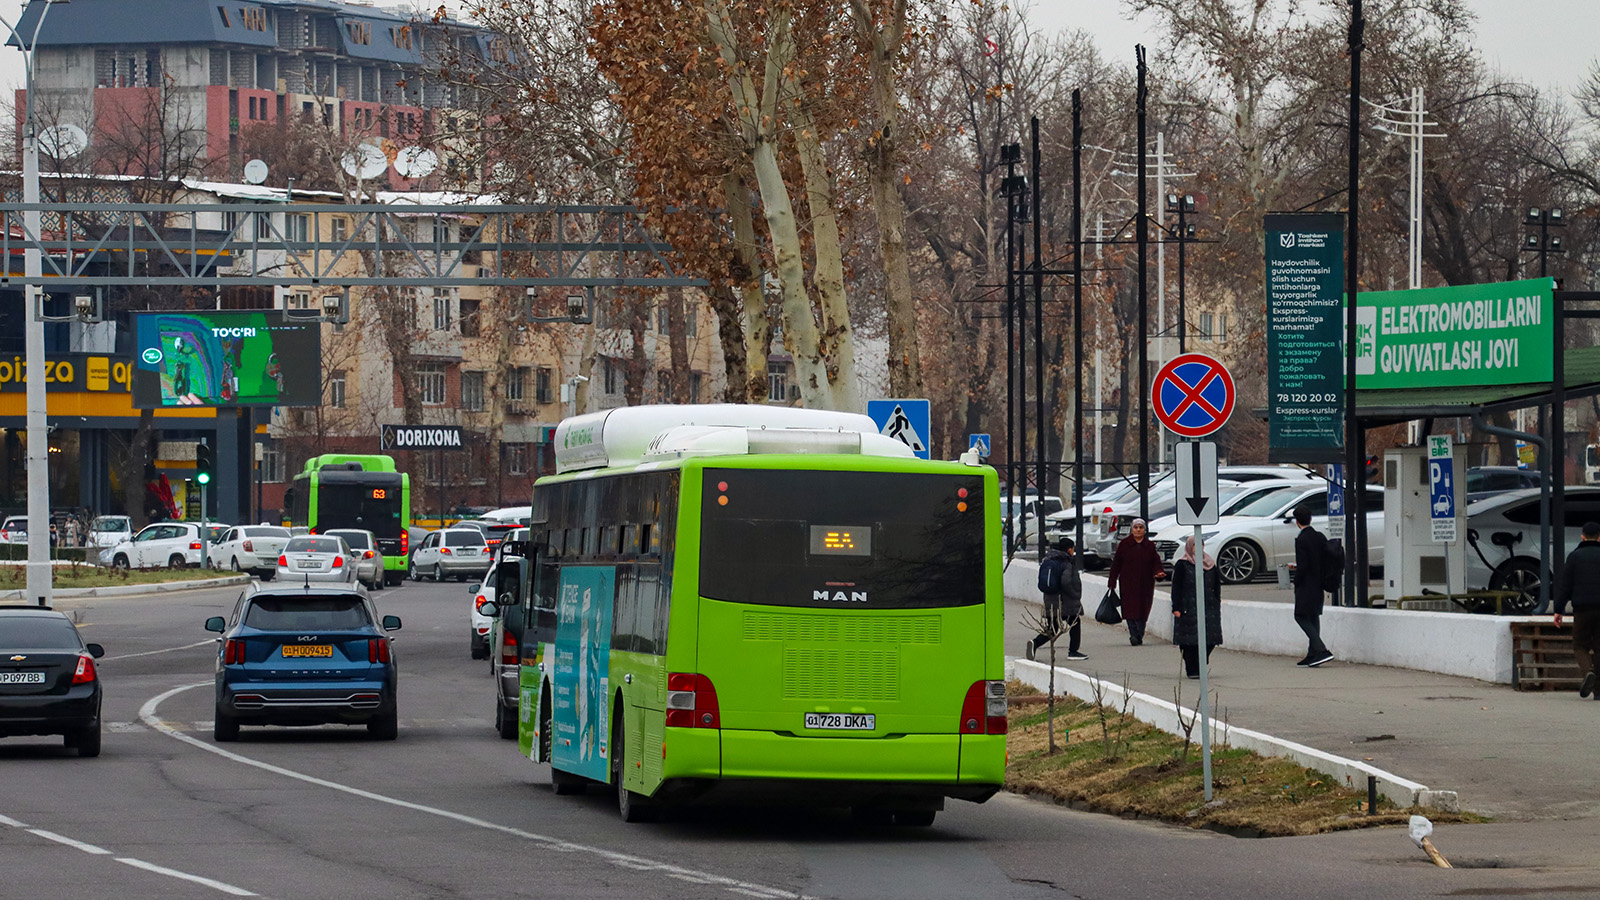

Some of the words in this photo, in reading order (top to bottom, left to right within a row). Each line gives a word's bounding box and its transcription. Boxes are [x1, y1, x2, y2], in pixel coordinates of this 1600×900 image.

[1271, 267, 1331, 275] guvohnomasini
[1272, 283, 1321, 291] imtihonlarga
[1381, 295, 1541, 335] ELEKTROMOBILLARNI
[1272, 323, 1315, 331] marhamat!
[1290, 357, 1317, 365] права?
[1380, 340, 1481, 374] QUVVATLASH
[1485, 338, 1519, 369] JOYI
[1276, 394, 1289, 402] 78
[1291, 394, 1307, 402] 120
[1309, 394, 1322, 402] 20
[1324, 394, 1337, 402] 02
[396, 429, 461, 446] DORIXONA
[1430, 462, 1441, 495] P
[372, 488, 386, 499] 63
[813, 590, 867, 602] MAN
[808, 716, 819, 726] 01
[820, 715, 841, 727] 728
[844, 715, 868, 728] DKA
